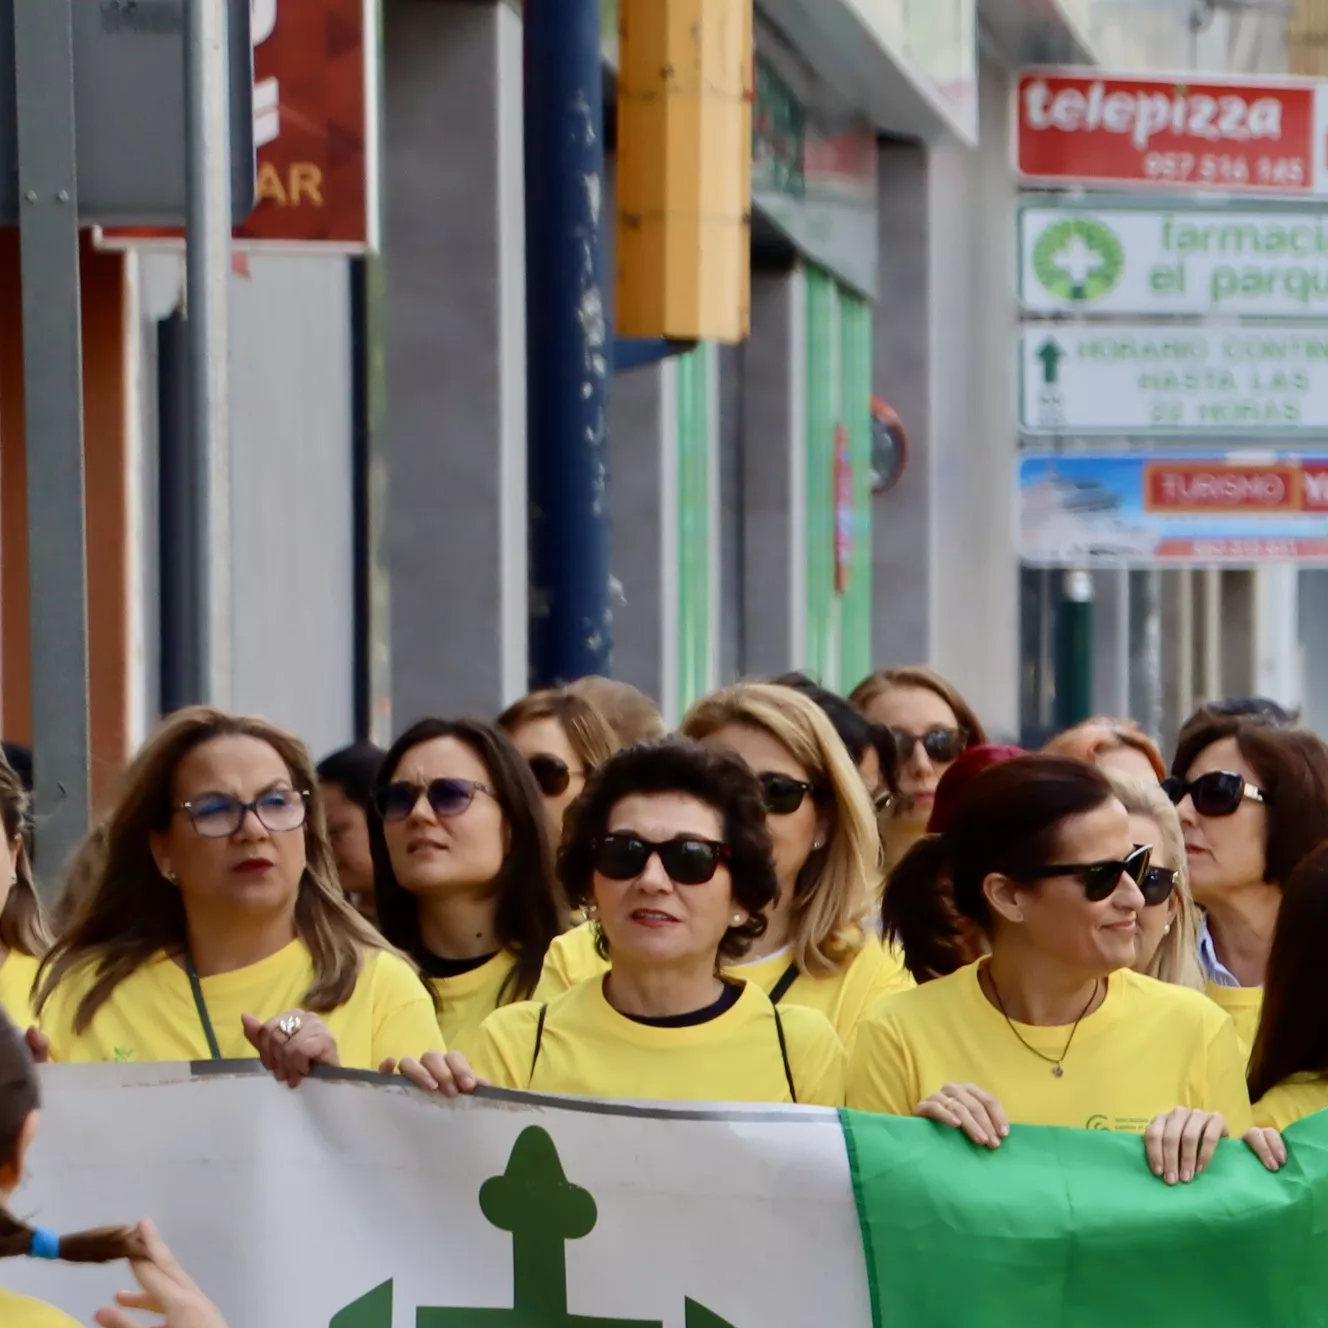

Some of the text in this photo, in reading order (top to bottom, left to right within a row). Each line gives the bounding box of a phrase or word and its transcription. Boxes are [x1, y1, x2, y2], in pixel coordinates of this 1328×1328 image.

[1024, 80, 1283, 150] telepizza
[1148, 262, 1186, 294] el
[1137, 368, 1310, 391] HASTA LAS
[1161, 472, 1286, 504] TURISMO
